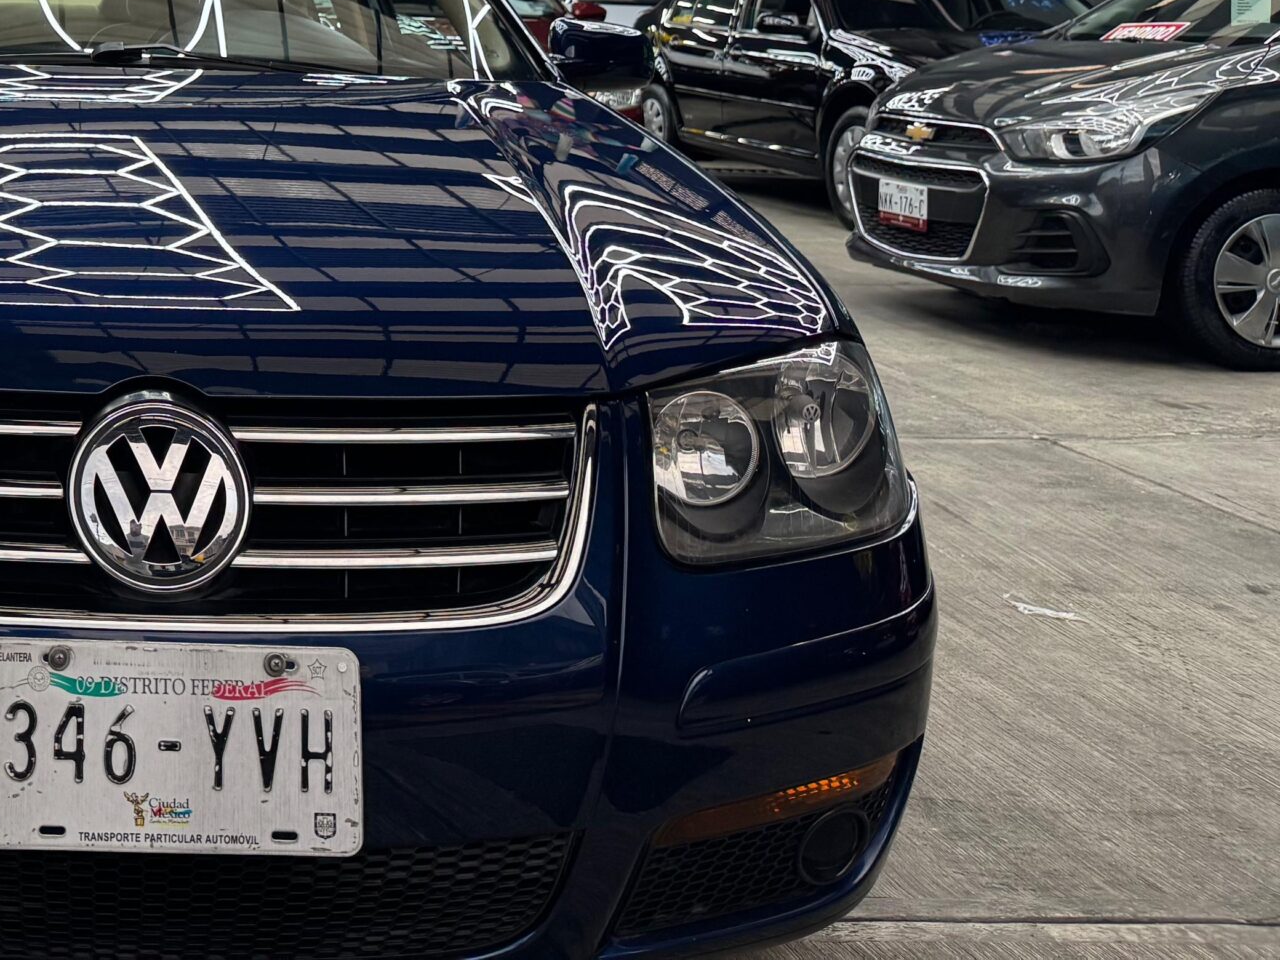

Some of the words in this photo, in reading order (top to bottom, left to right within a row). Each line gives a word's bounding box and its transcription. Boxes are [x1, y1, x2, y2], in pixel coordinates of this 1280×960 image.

[84, 418, 234, 572] VW
[75, 675, 95, 693] 09
[99, 676, 186, 696] DISTRITO
[190, 678, 270, 698] FEDERAL
[4, 700, 335, 795] 346-YVH
[148, 797, 190, 809] Ciudad
[79, 831, 141, 843] TRANSPORTE
[144, 833, 203, 844] PARTICULAR
[206, 832, 260, 845] AUTOMÓVIL
